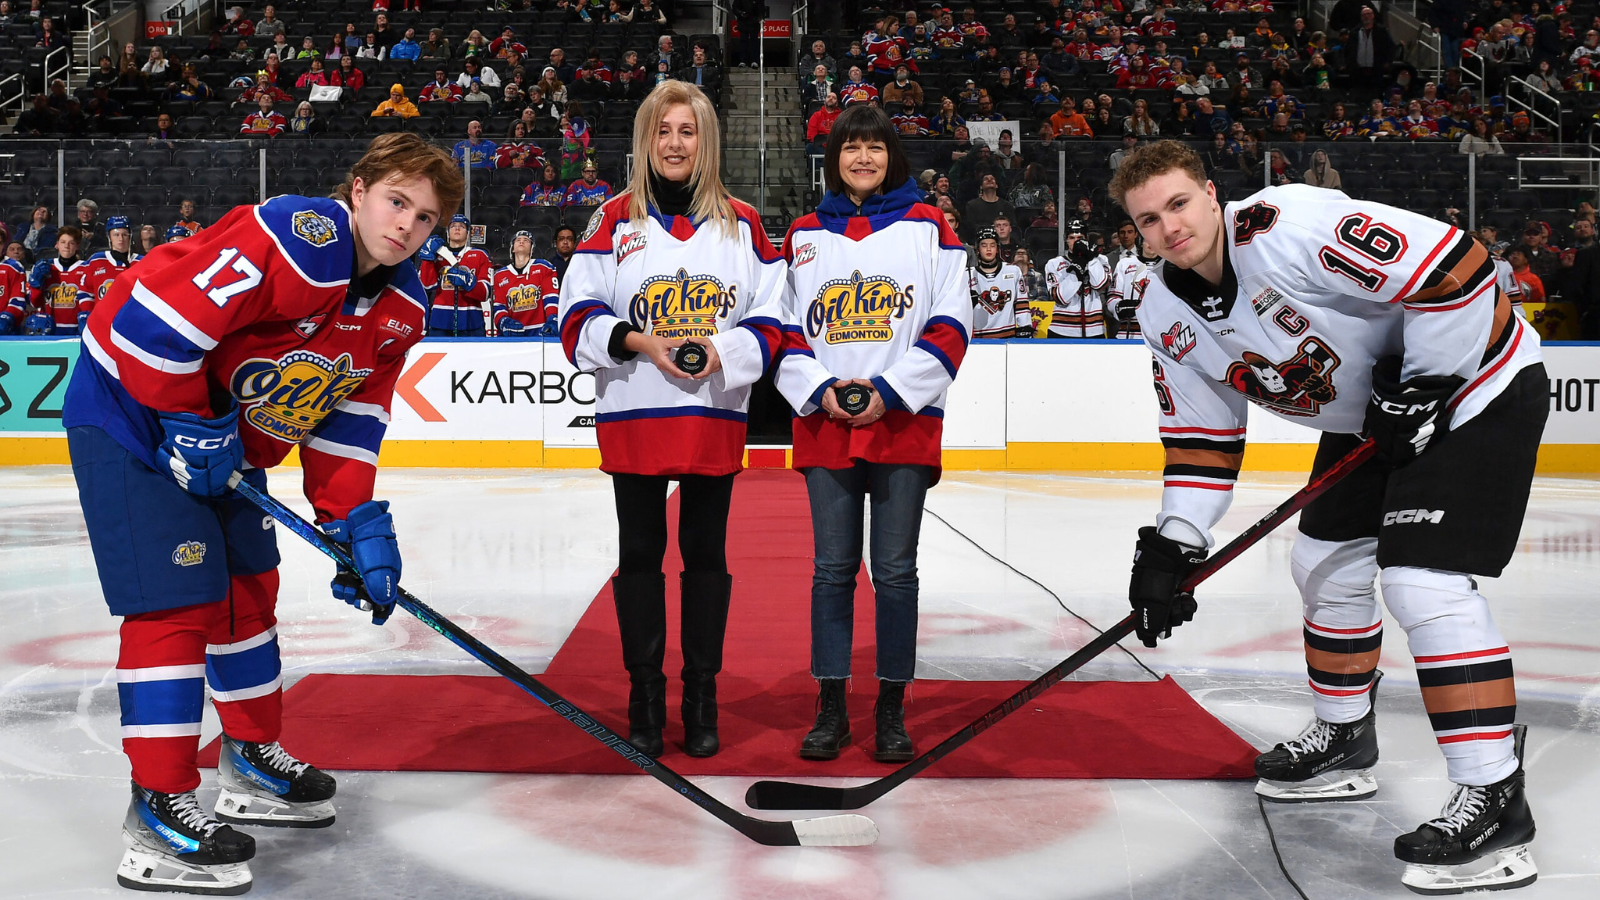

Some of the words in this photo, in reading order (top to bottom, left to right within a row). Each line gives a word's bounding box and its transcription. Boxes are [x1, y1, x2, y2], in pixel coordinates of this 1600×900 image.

[617, 236, 648, 258] WHL
[1318, 212, 1409, 293] 16
[191, 246, 264, 309] 17
[551, 276, 559, 290] 9
[628, 287, 679, 332] Oil
[680, 279, 738, 319] Kings
[807, 290, 852, 339] Oil
[854, 281, 914, 319] Kings
[387, 318, 414, 336] ELITE
[655, 327, 714, 338] EDMONTON
[1272, 304, 1311, 338] C
[829, 330, 889, 342] EDMONTON
[231, 358, 324, 409] Oil
[174, 426, 240, 450] CCM
[1383, 509, 1445, 526] CCM
[551, 699, 656, 770] BAUER
[1311, 752, 1345, 775] BAUER
[155, 824, 190, 851] BAUER
[1469, 822, 1501, 851] BAUER
